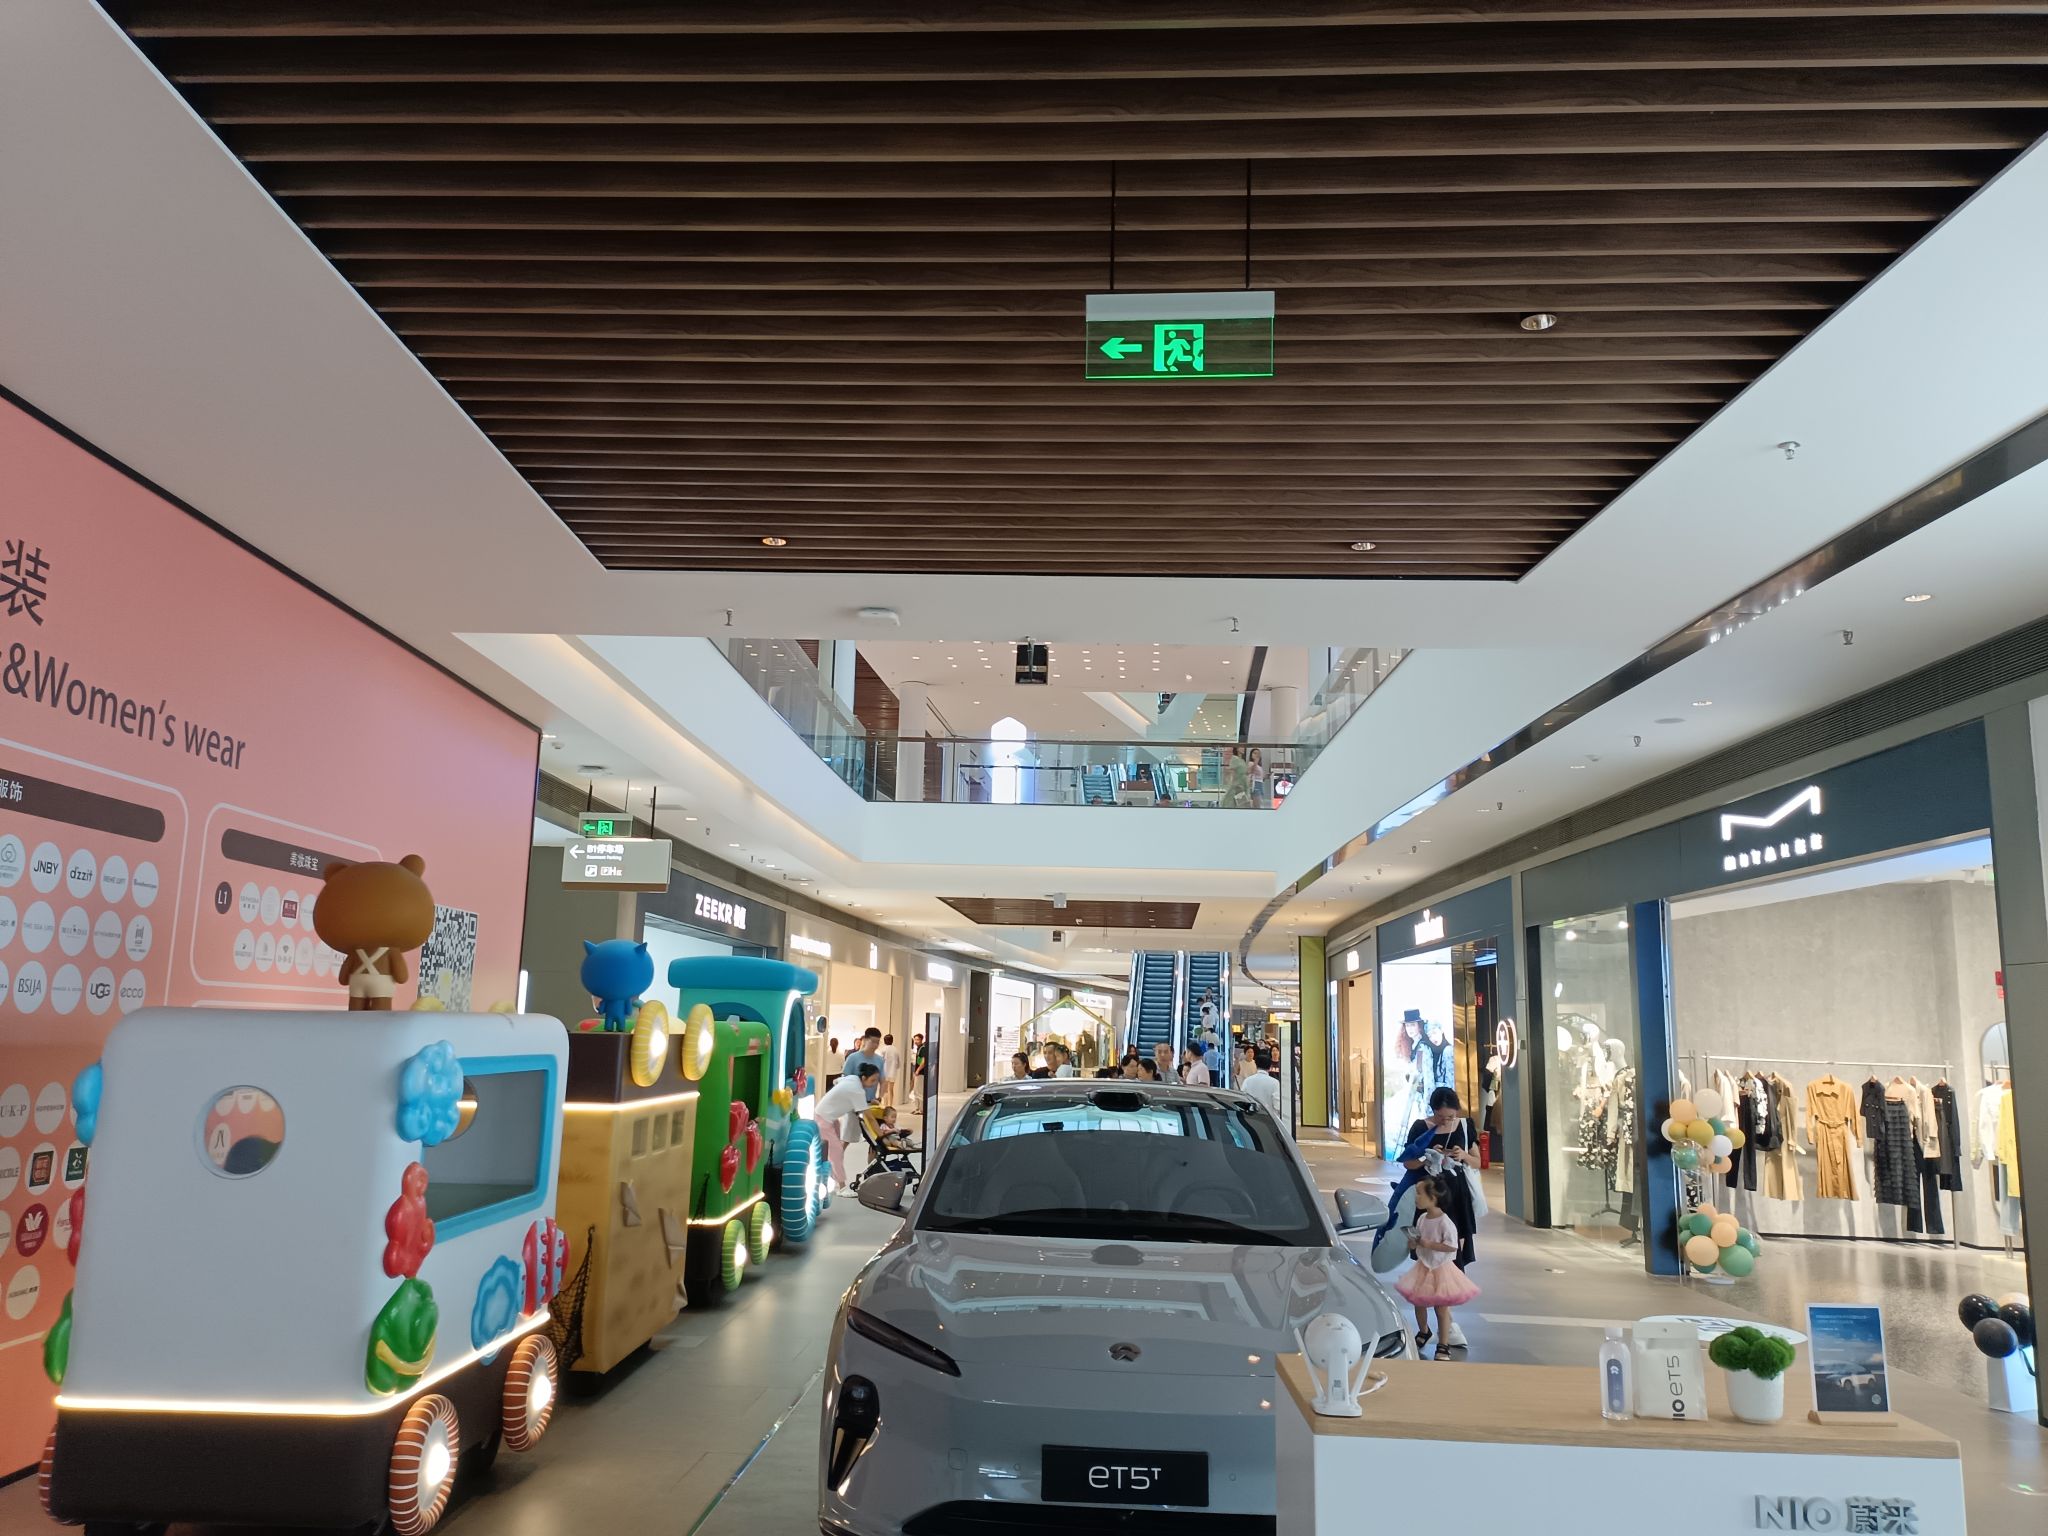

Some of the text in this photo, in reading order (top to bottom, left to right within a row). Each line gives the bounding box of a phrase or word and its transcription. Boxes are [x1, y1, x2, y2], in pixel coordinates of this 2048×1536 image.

[184, 720, 246, 769] wear
[33, 860, 59, 875] JNBY
[217, 890, 228, 904] L1
[694, 893, 733, 925] ZEEKR
[90, 983, 111, 999] UGG
[120, 987, 144, 999] ecco
[1754, 1495, 1920, 1536] NIO 蔚来
